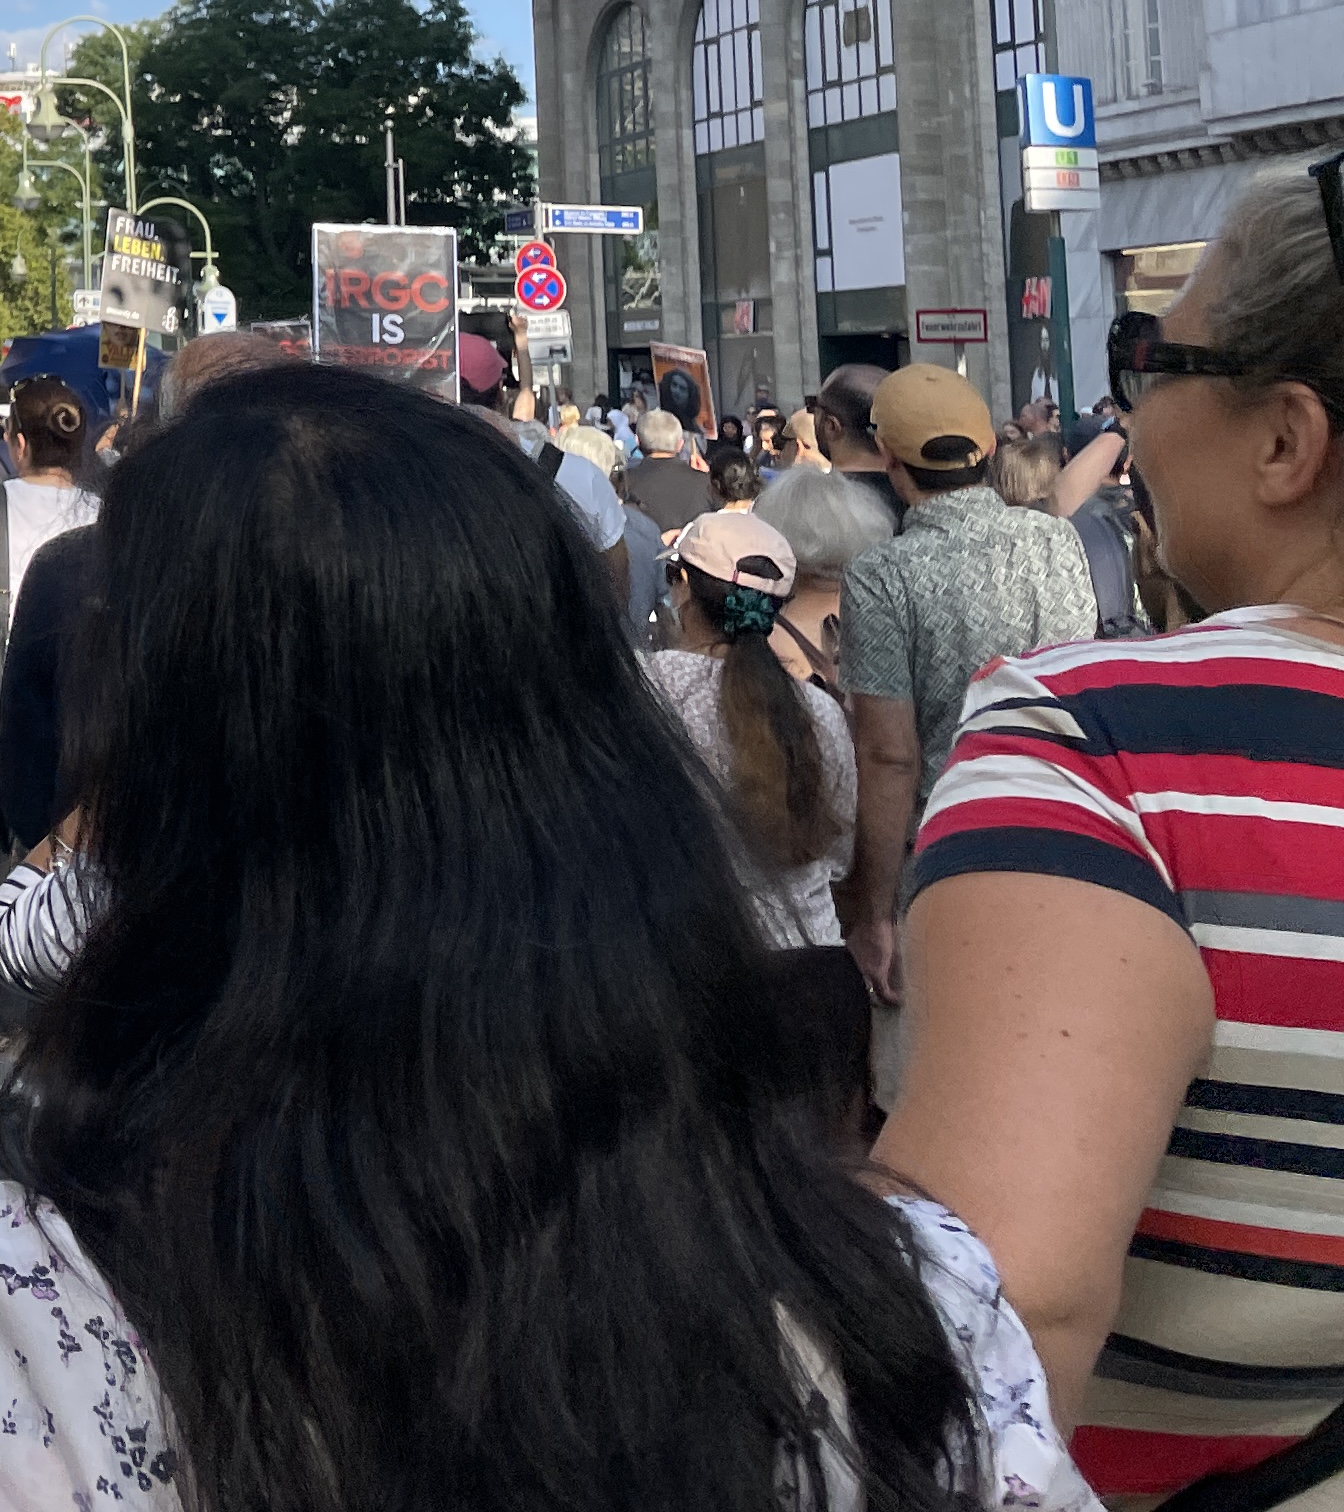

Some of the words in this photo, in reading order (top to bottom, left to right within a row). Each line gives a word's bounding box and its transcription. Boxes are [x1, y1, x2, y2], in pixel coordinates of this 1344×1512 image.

[1042, 81, 1085, 138] U
[115, 216, 159, 240] FRAU.
[114, 235, 165, 261] LEBEN.
[112, 254, 182, 285] FREIHEIT.
[325, 268, 450, 313] IRGC
[372, 313, 405, 345] IS
